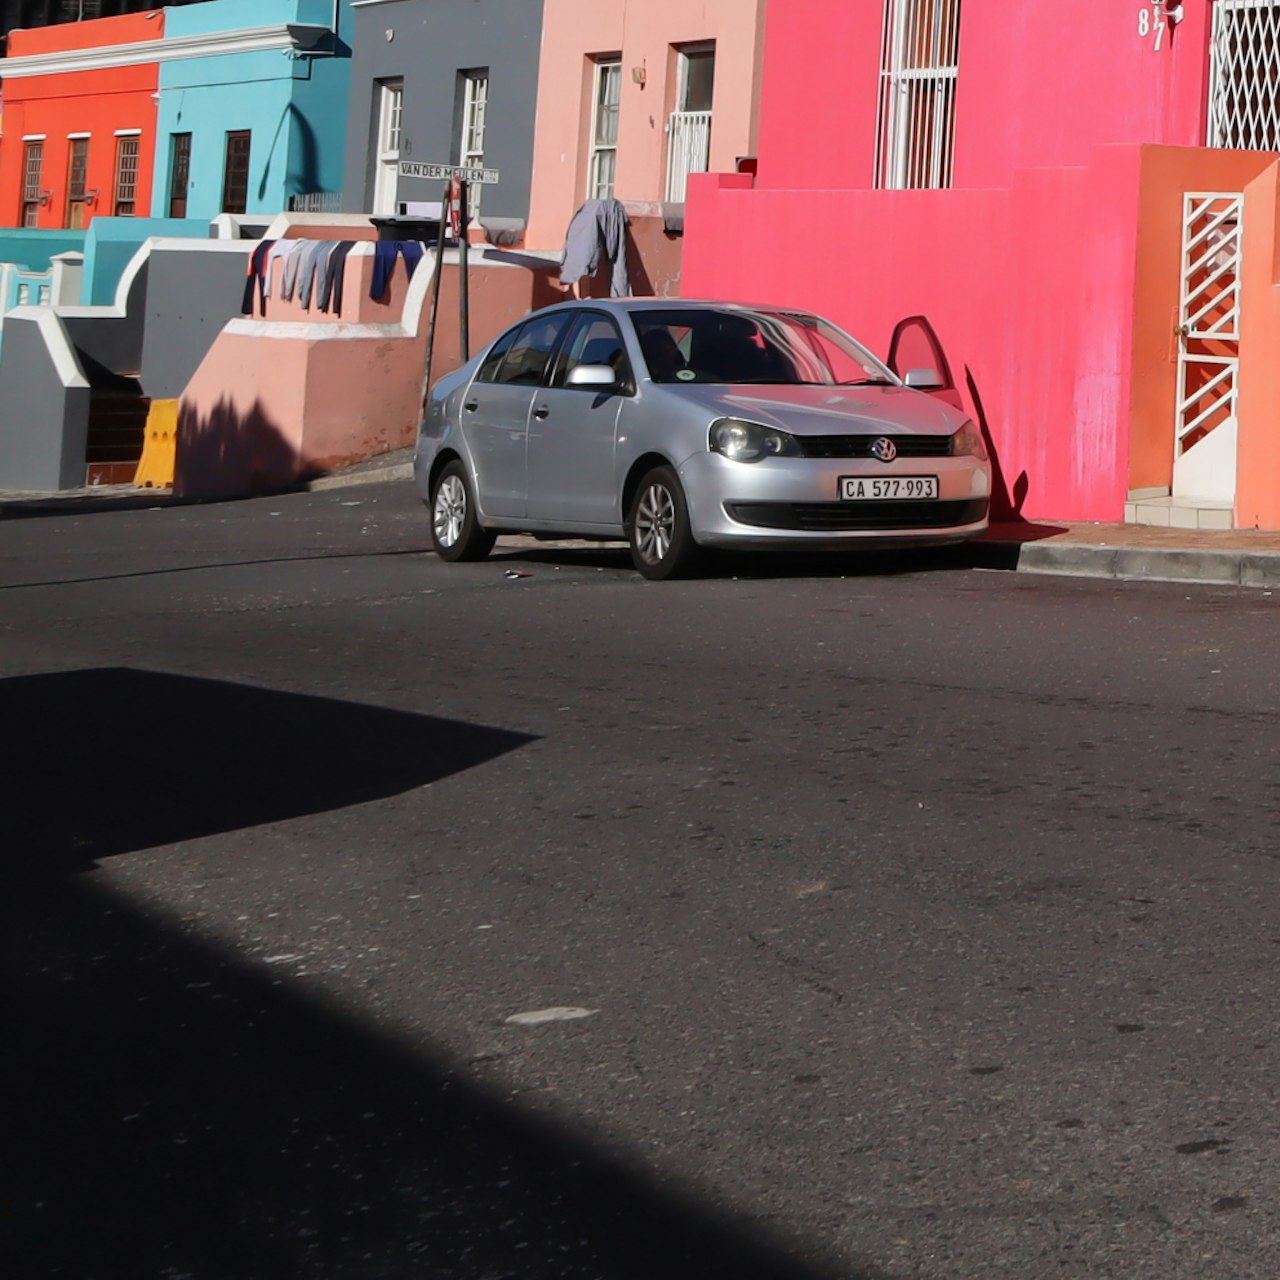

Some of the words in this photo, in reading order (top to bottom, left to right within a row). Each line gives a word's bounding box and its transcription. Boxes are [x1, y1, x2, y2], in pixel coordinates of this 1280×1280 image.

[1138, 8, 1166, 51] 87
[401, 163, 420, 175] VAN
[422, 166, 442, 178] DER
[444, 168, 484, 181] MEULEN
[846, 481, 865, 497] CA
